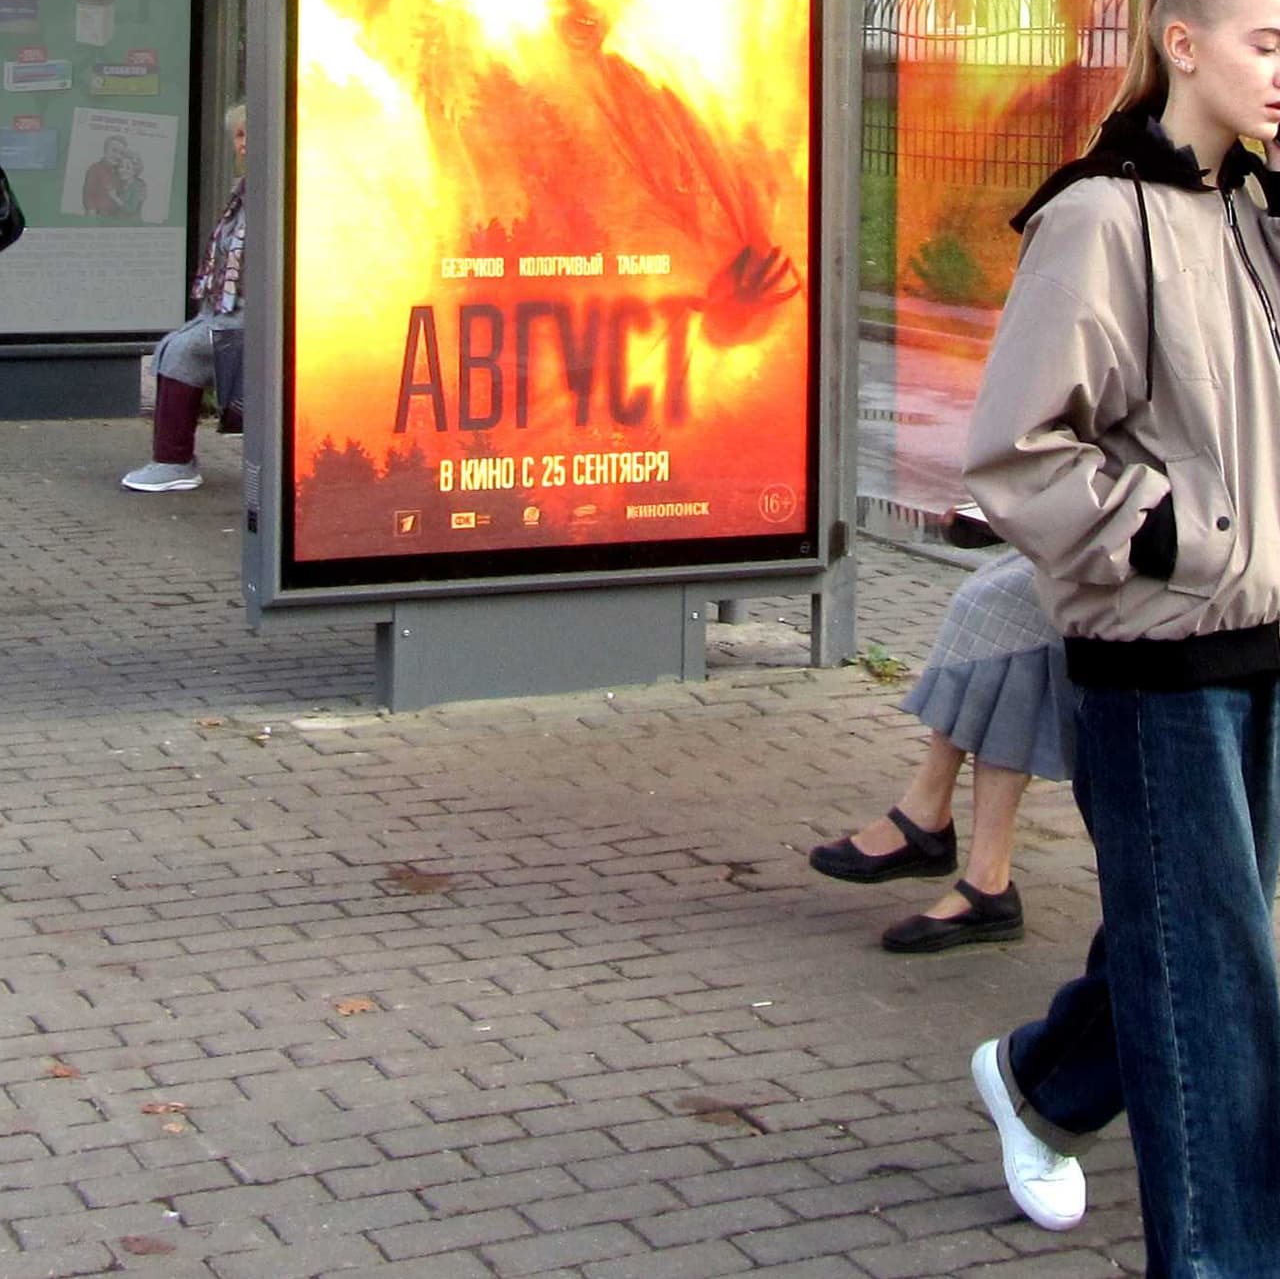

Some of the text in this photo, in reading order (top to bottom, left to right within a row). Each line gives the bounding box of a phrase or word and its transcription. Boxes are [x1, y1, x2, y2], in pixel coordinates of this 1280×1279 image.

[441, 252, 671, 279] БЕЗРУКОВ КОЛОГРИВЫЙ ТАБАКОВ
[393, 298, 698, 434] АВГУСТ
[439, 450, 670, 492] В КИНО С 25 СЕНТЯБРЯ
[762, 492, 792, 515] 16+
